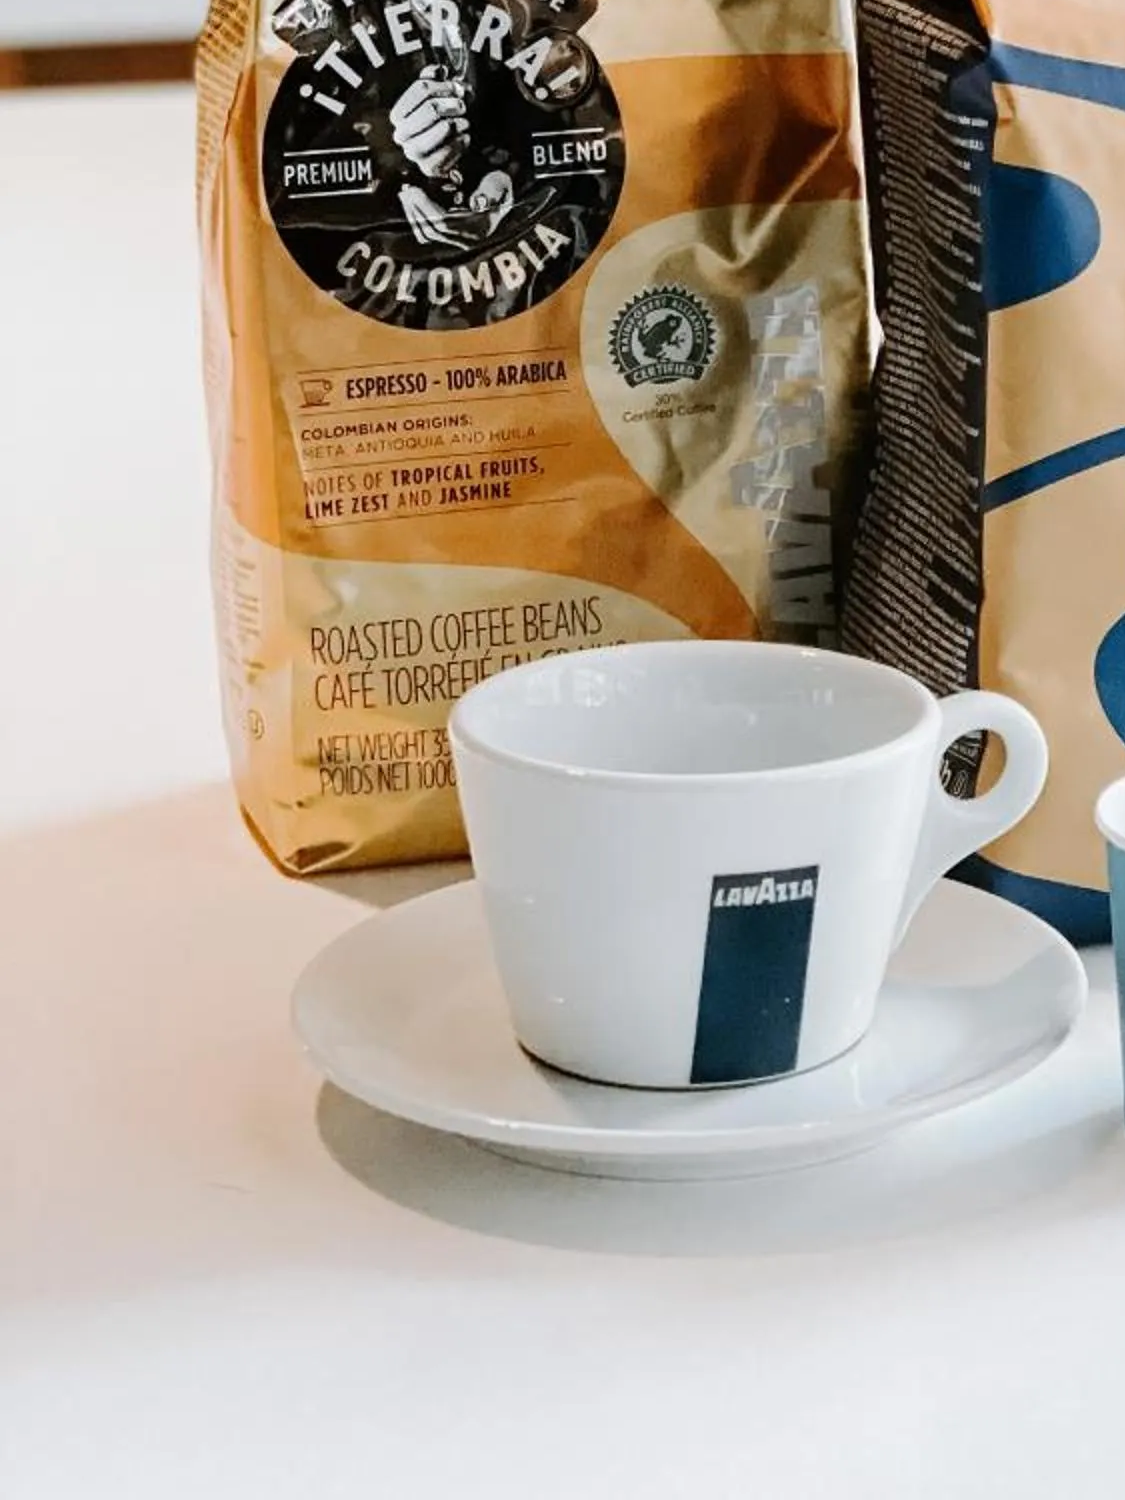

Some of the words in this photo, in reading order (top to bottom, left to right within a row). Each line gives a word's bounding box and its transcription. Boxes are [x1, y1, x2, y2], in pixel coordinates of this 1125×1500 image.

[283, 158, 374, 189] PREMIUM
[533, 139, 607, 168] BLEND
[336, 222, 572, 306] COLOMBIA
[345, 371, 428, 401] ESPRESSO
[445, 366, 492, 391] 100%
[495, 360, 568, 388] ARABICA
[301, 421, 398, 442] COLOMBIAN
[402, 414, 473, 432] ORIGINS:
[451, 430, 486, 446] AND
[304, 476, 358, 498] NOTES
[363, 471, 385, 491] OF
[390, 463, 473, 487] TROPICAL
[480, 456, 545, 479] FRUITS,
[305, 499, 345, 521] LIME
[351, 494, 390, 515] ZEST
[397, 490, 433, 509] AND
[438, 482, 513, 506] JASMINE
[310, 618, 424, 666] ROASTED
[430, 605, 516, 654] COFFEE
[522, 596, 603, 643] BEANS
[314, 660, 378, 712] CAFÉ
[317, 734, 352, 765] NET
[356, 729, 427, 763] WEIGHT
[319, 762, 374, 797] POIDS
[377, 761, 411, 794] NET
[713, 876, 815, 908] LAVAZZA
